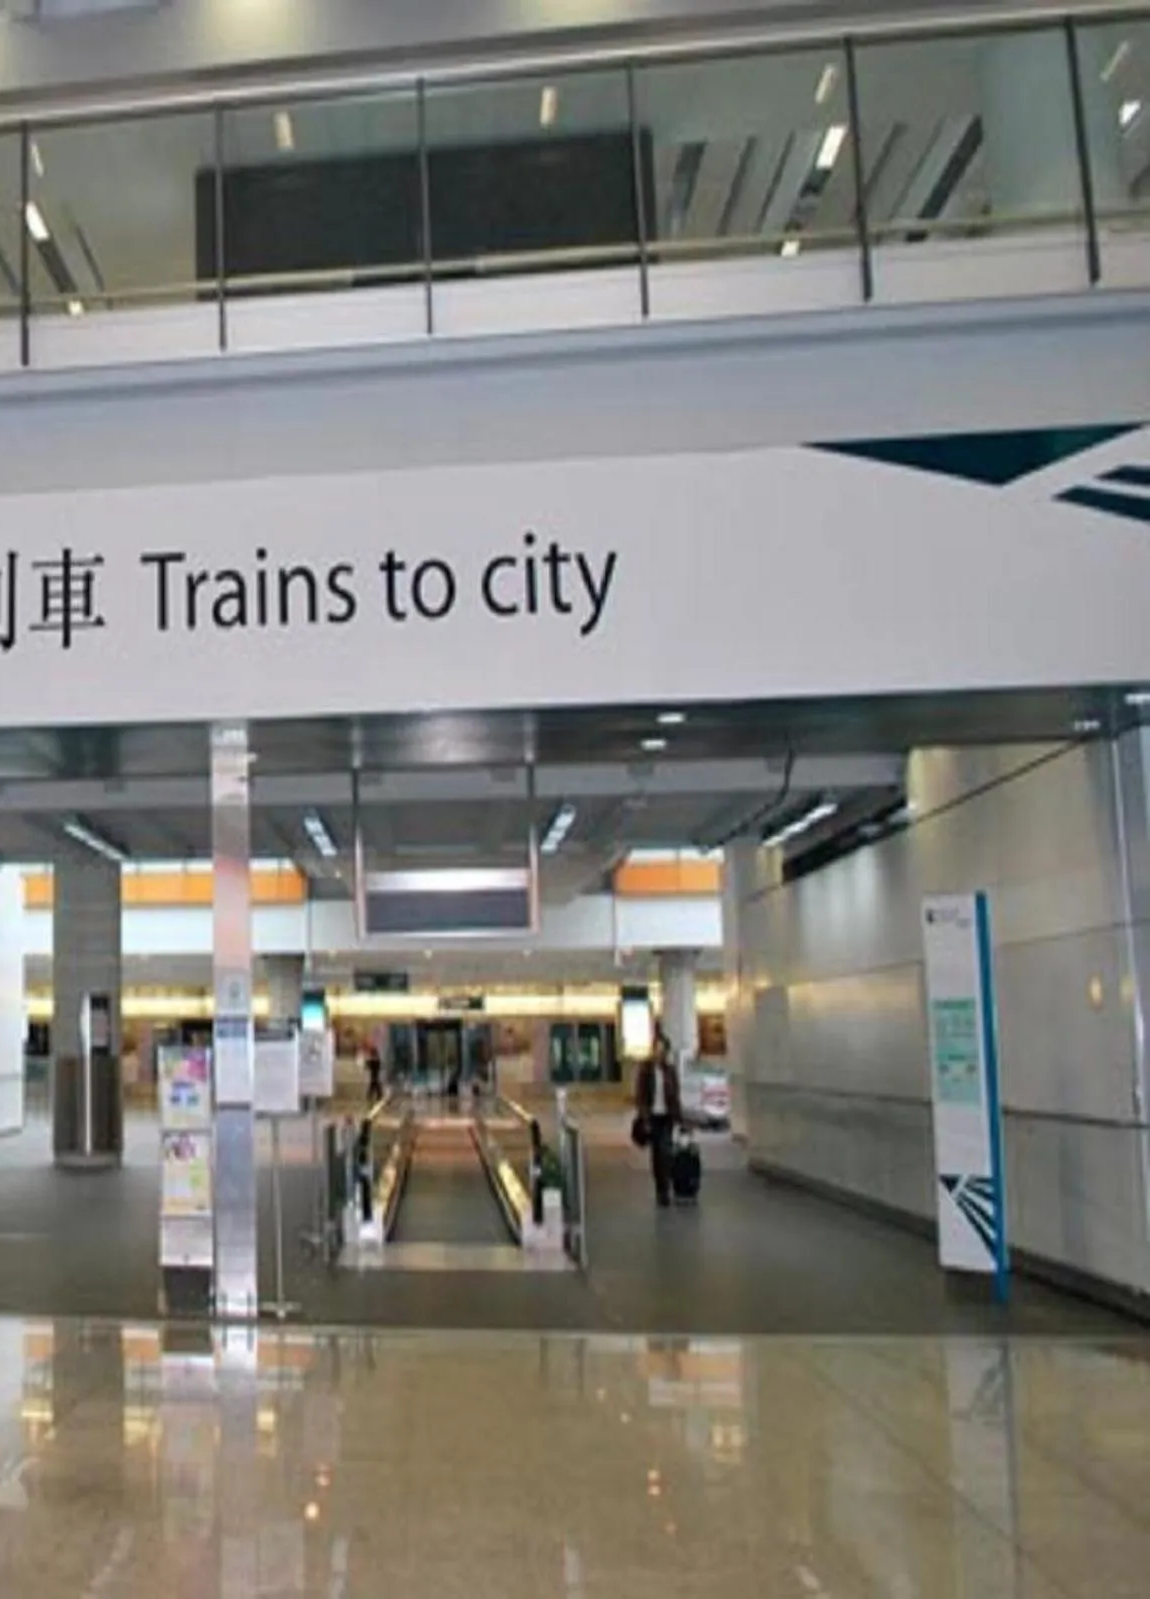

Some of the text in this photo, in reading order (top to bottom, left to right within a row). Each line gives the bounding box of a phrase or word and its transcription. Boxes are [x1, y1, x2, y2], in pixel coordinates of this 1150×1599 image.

[140, 531, 617, 637] Trains to city
